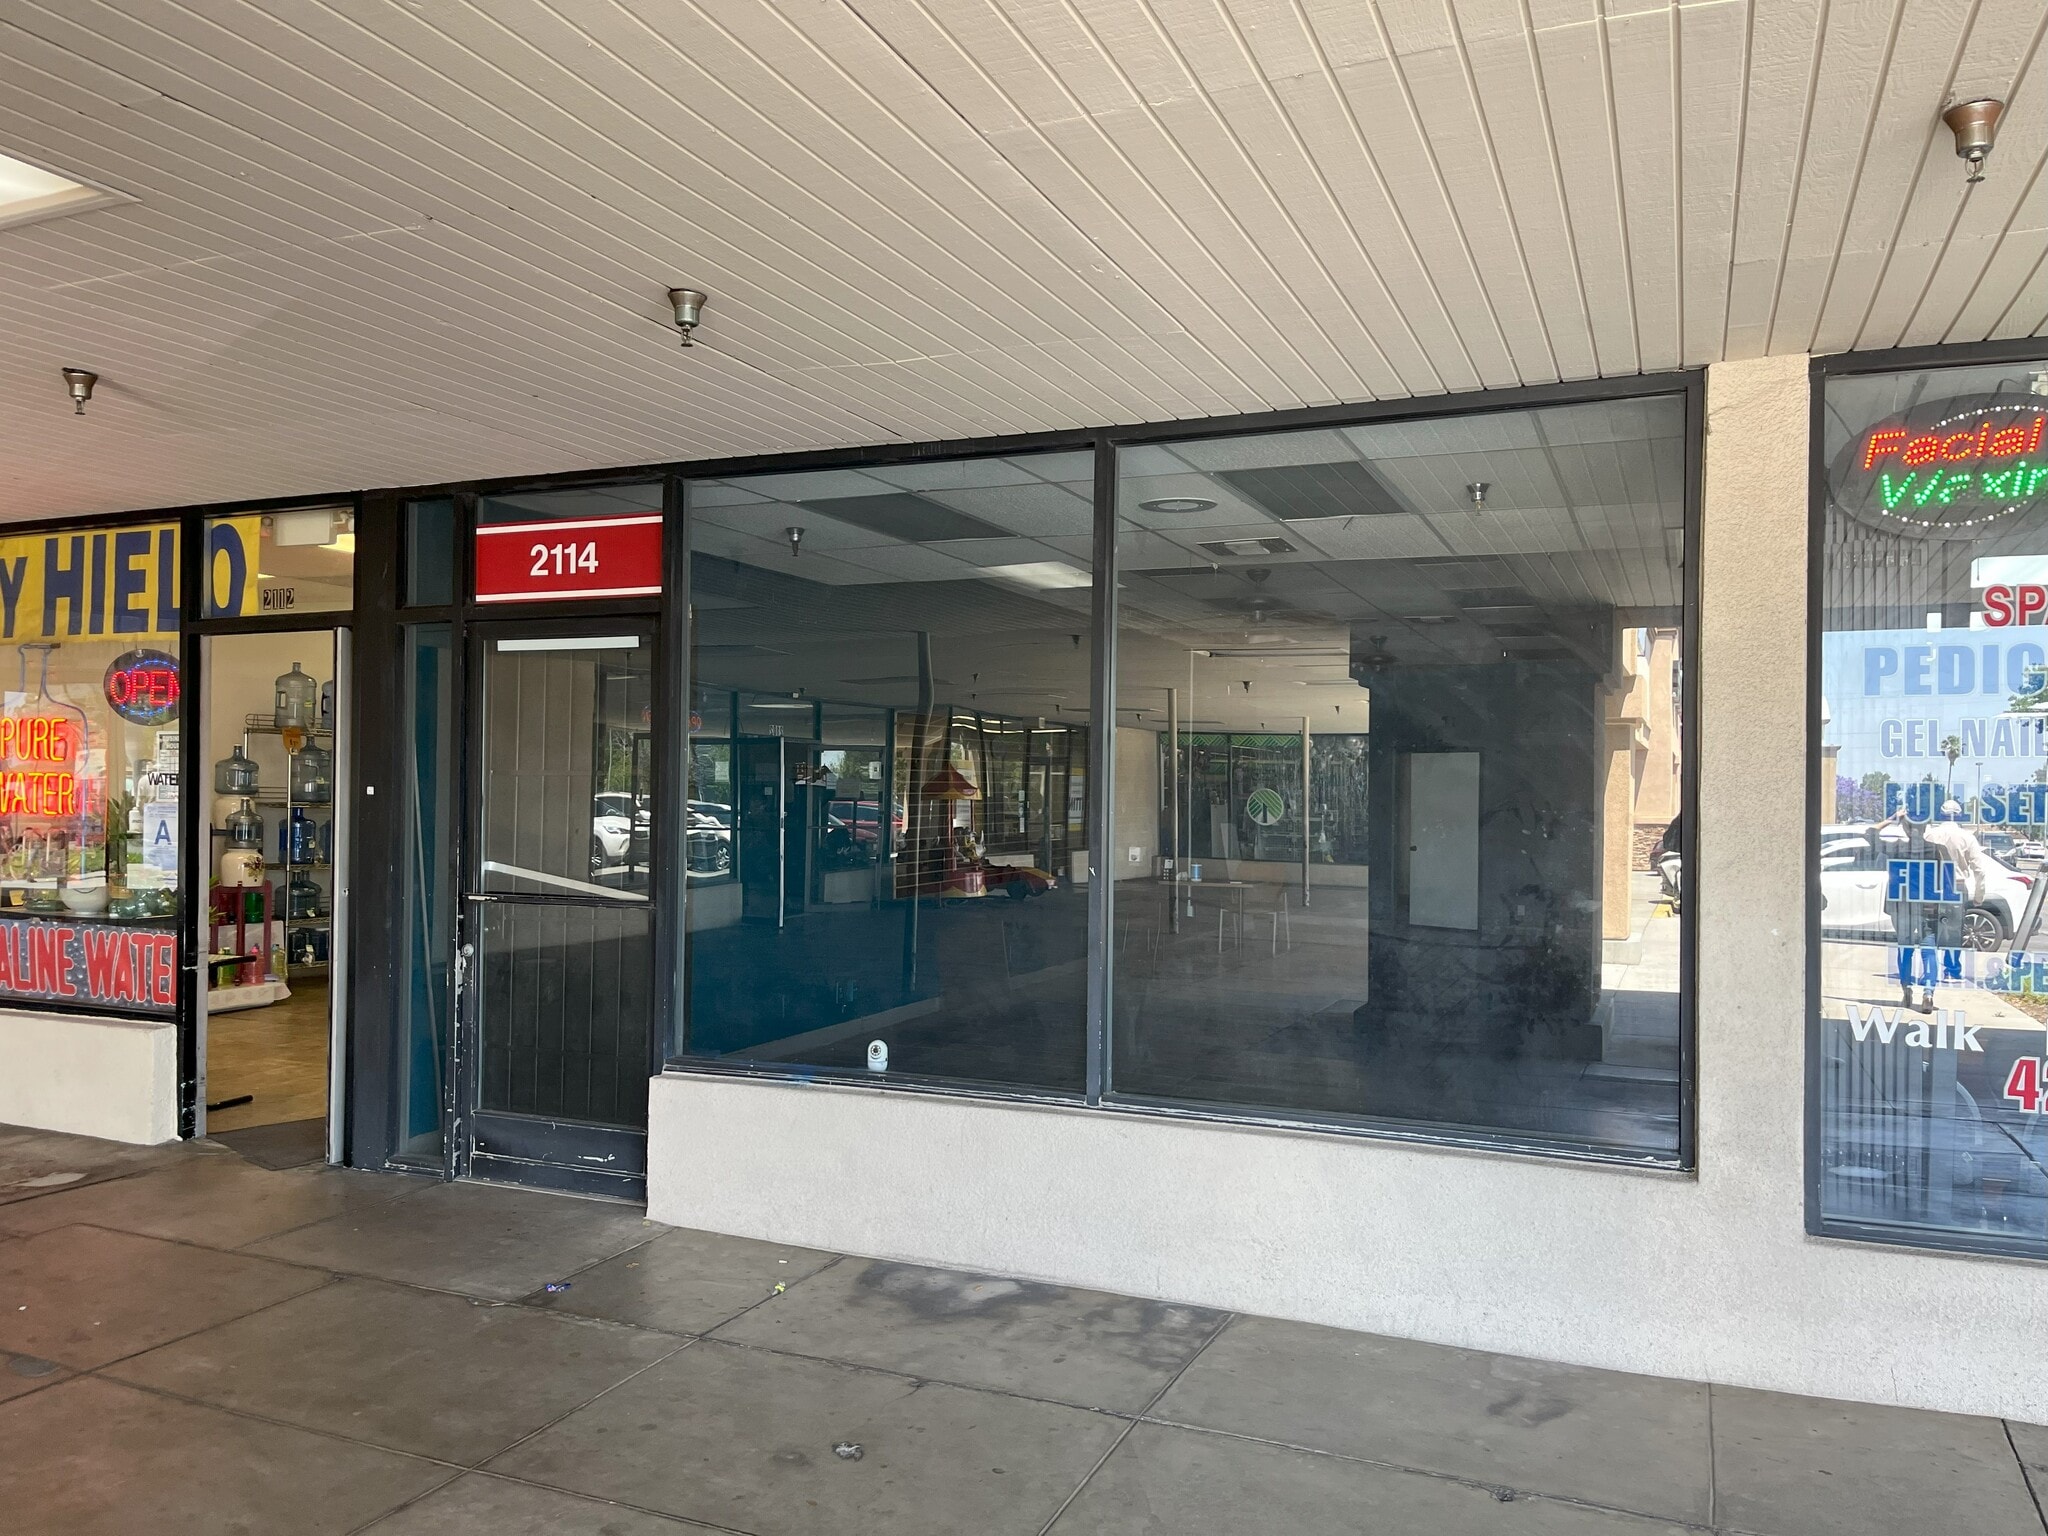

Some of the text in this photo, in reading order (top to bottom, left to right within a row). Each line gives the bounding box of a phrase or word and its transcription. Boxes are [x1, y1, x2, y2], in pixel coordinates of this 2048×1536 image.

[1863, 416, 2043, 469] Facial
[530, 541, 599, 576] 2114
[263, 588, 295, 611] 2112
[1982, 584, 2048, 628] SP
[0, 717, 67, 761] PURE
[1880, 718, 1944, 758] GEL
[147, 772, 179, 785] WATE
[1883, 782, 2048, 824] FULL SET
[154, 819, 172, 845] A
[1887, 859, 1963, 902] FILL
[1846, 1004, 1984, 1052] Walk
[2003, 1056, 2048, 1114] 4
